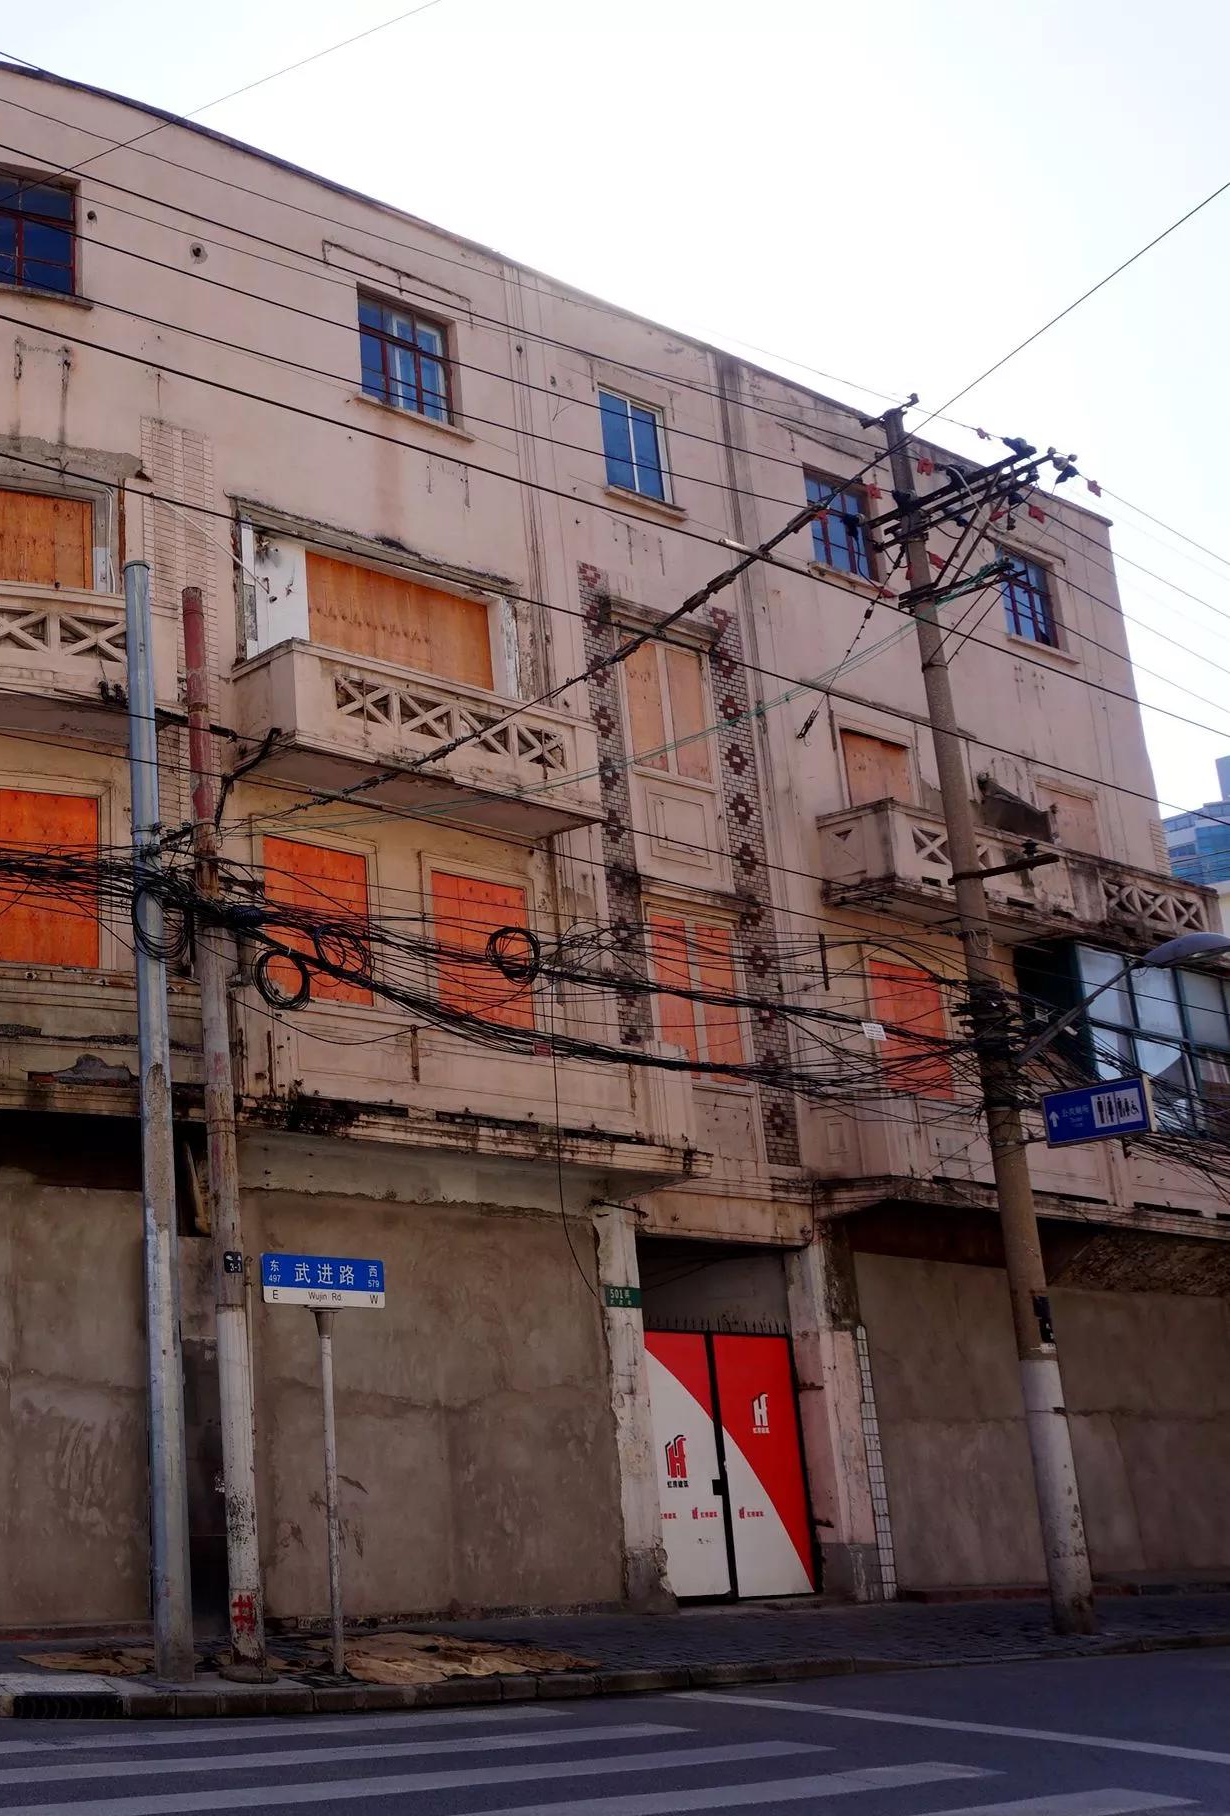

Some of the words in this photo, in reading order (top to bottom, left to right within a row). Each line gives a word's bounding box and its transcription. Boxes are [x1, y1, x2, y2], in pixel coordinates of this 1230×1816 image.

[269, 1260, 280, 1272] 东
[294, 1262, 355, 1286] 武进路
[367, 1265, 378, 1278] 西
[268, 1274, 281, 1283] 497
[367, 1279, 380, 1288] 579
[272, 1290, 279, 1300] E
[308, 1291, 328, 1302] Wujin
[370, 1294, 379, 1304] W
